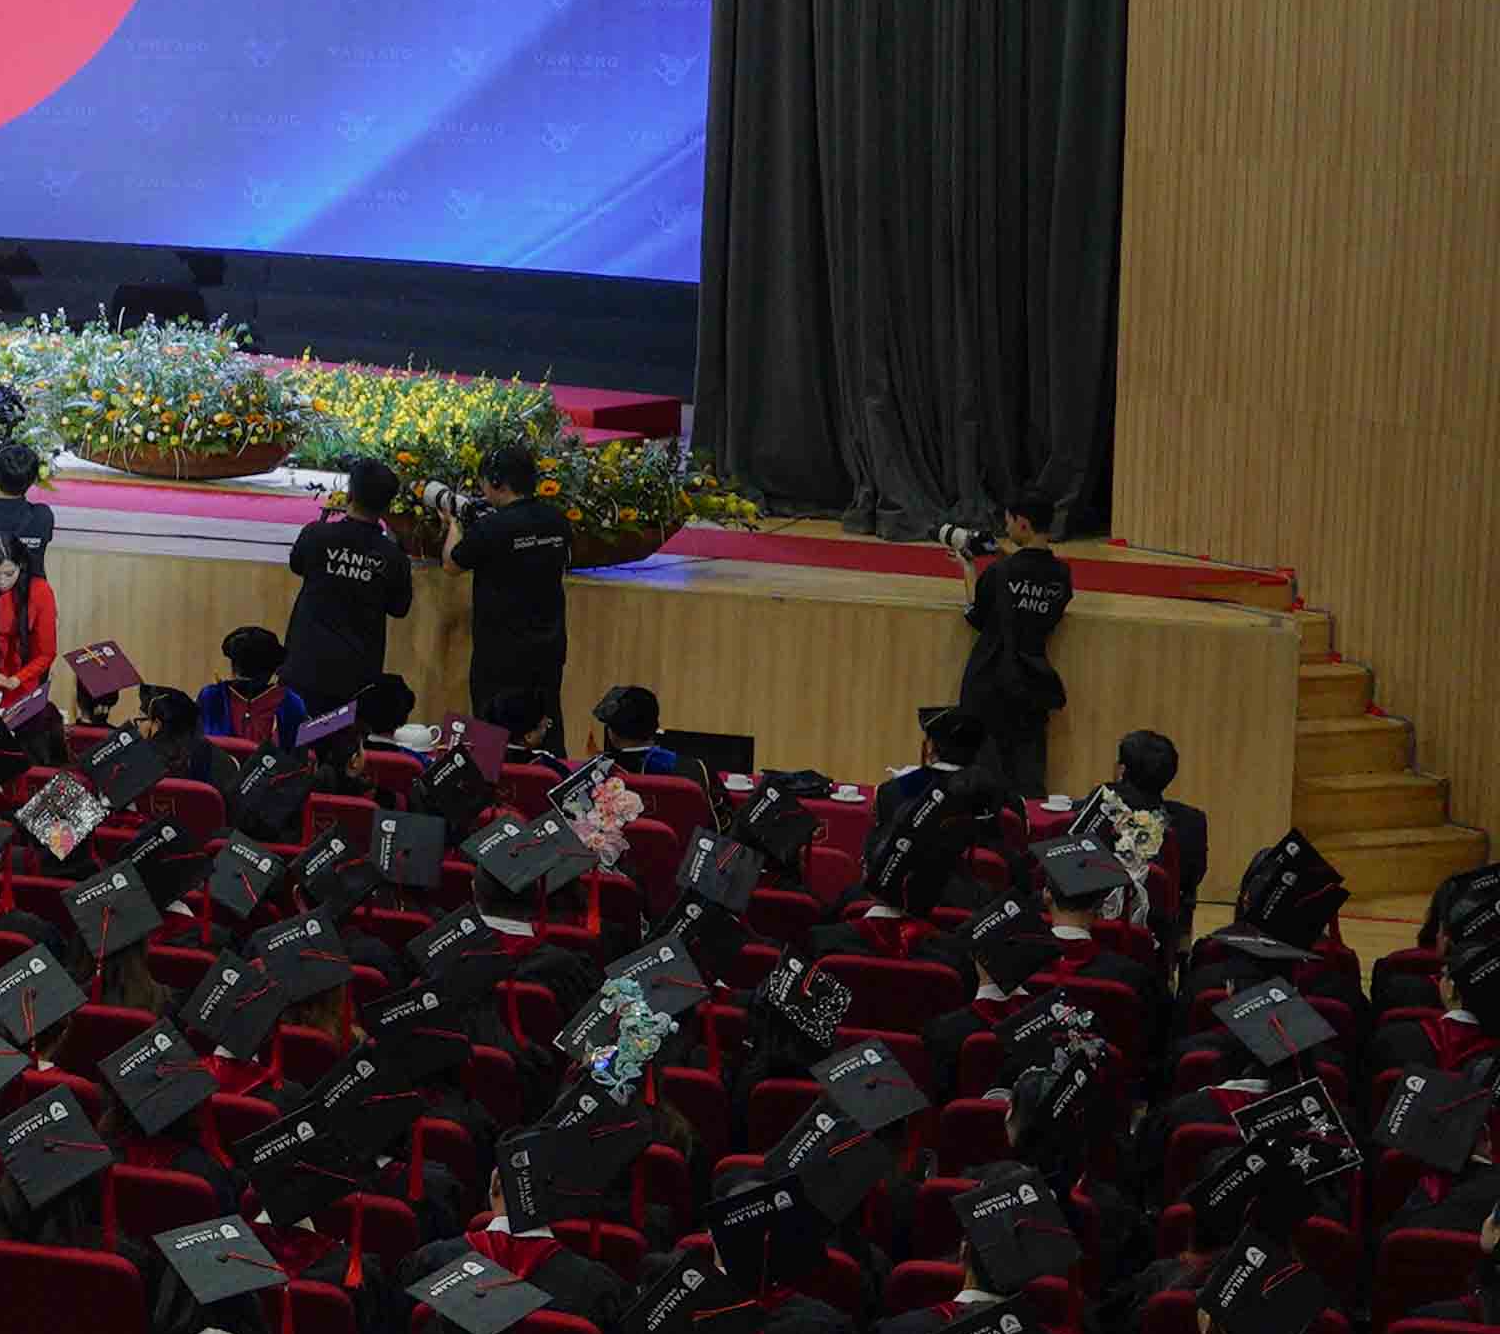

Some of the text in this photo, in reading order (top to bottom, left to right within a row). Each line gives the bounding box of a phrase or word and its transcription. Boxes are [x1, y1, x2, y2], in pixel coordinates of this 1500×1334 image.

[326, 548, 363, 566] VĂN
[326, 562, 372, 582] LANG
[1009, 580, 1044, 597] VĂN
[1014, 596, 1050, 614] ANG
[380, 1004, 425, 1025] VANLANG
[1232, 997, 1270, 1020] VANLANG
[120, 1047, 159, 1076] VANLANG
[828, 1057, 868, 1082] VANLANG
[324, 1078, 360, 1108] VANLANG
[1389, 1091, 1415, 1135] VANLANG
[8, 1115, 53, 1145] VANLANG
[252, 1133, 299, 1163] VANLANG
[788, 1130, 821, 1168] VANLANG
[1209, 1169, 1252, 1208] VANLANG
[724, 1203, 775, 1227] VANLANG
[973, 1196, 1021, 1219] VANLANG
[1220, 1263, 1255, 1307] VANLANG
[647, 1287, 688, 1332] VANLANG
